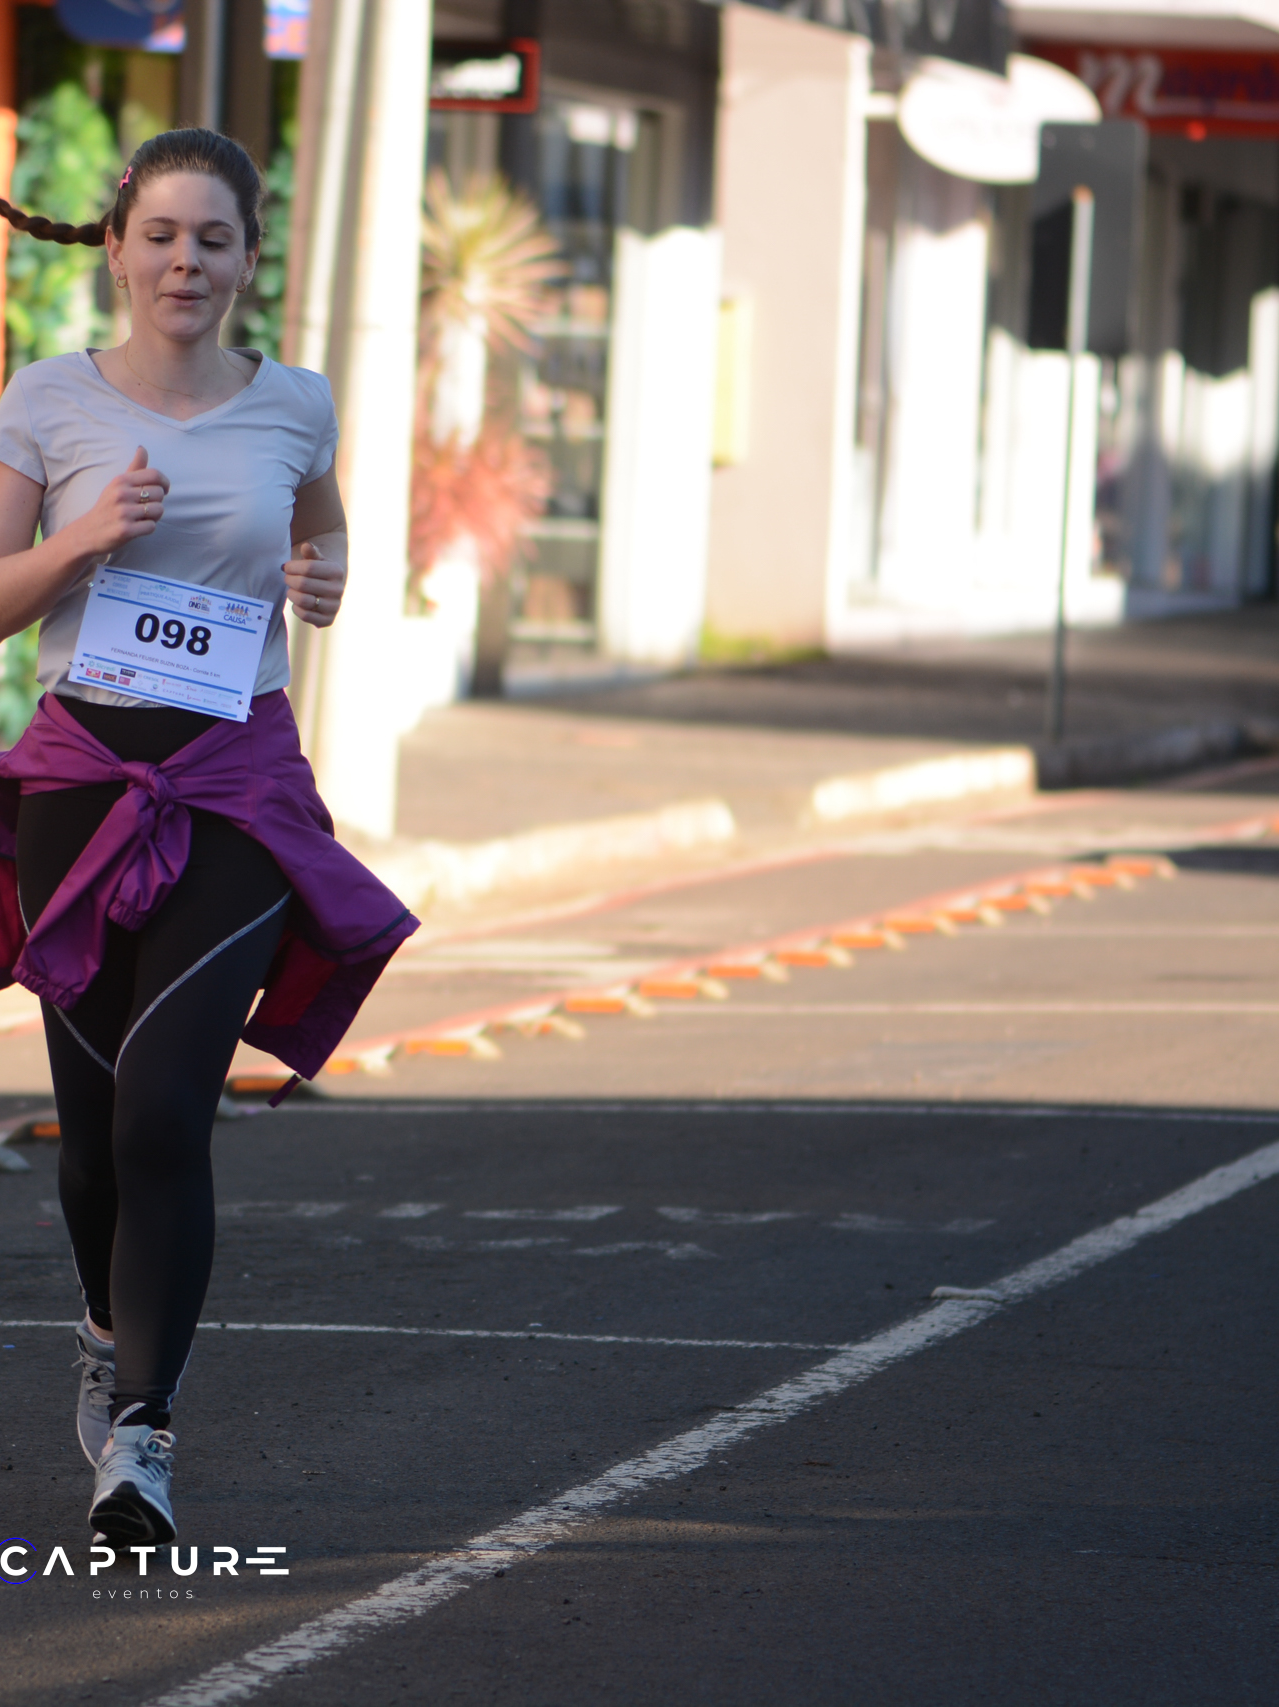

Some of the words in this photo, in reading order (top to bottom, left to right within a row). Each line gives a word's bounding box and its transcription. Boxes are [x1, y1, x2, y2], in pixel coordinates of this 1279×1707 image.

[188, 601, 201, 610] ONG
[223, 615, 246, 625] CAUSA
[135, 612, 212, 656] 098
[110, 647, 138, 658] FERNANDA
[138, 654, 159, 664] FEUSER
[175, 663, 190, 671] BOZA
[192, 667, 209, 676] Corrida
[96, 662, 116, 672] Sicredi
